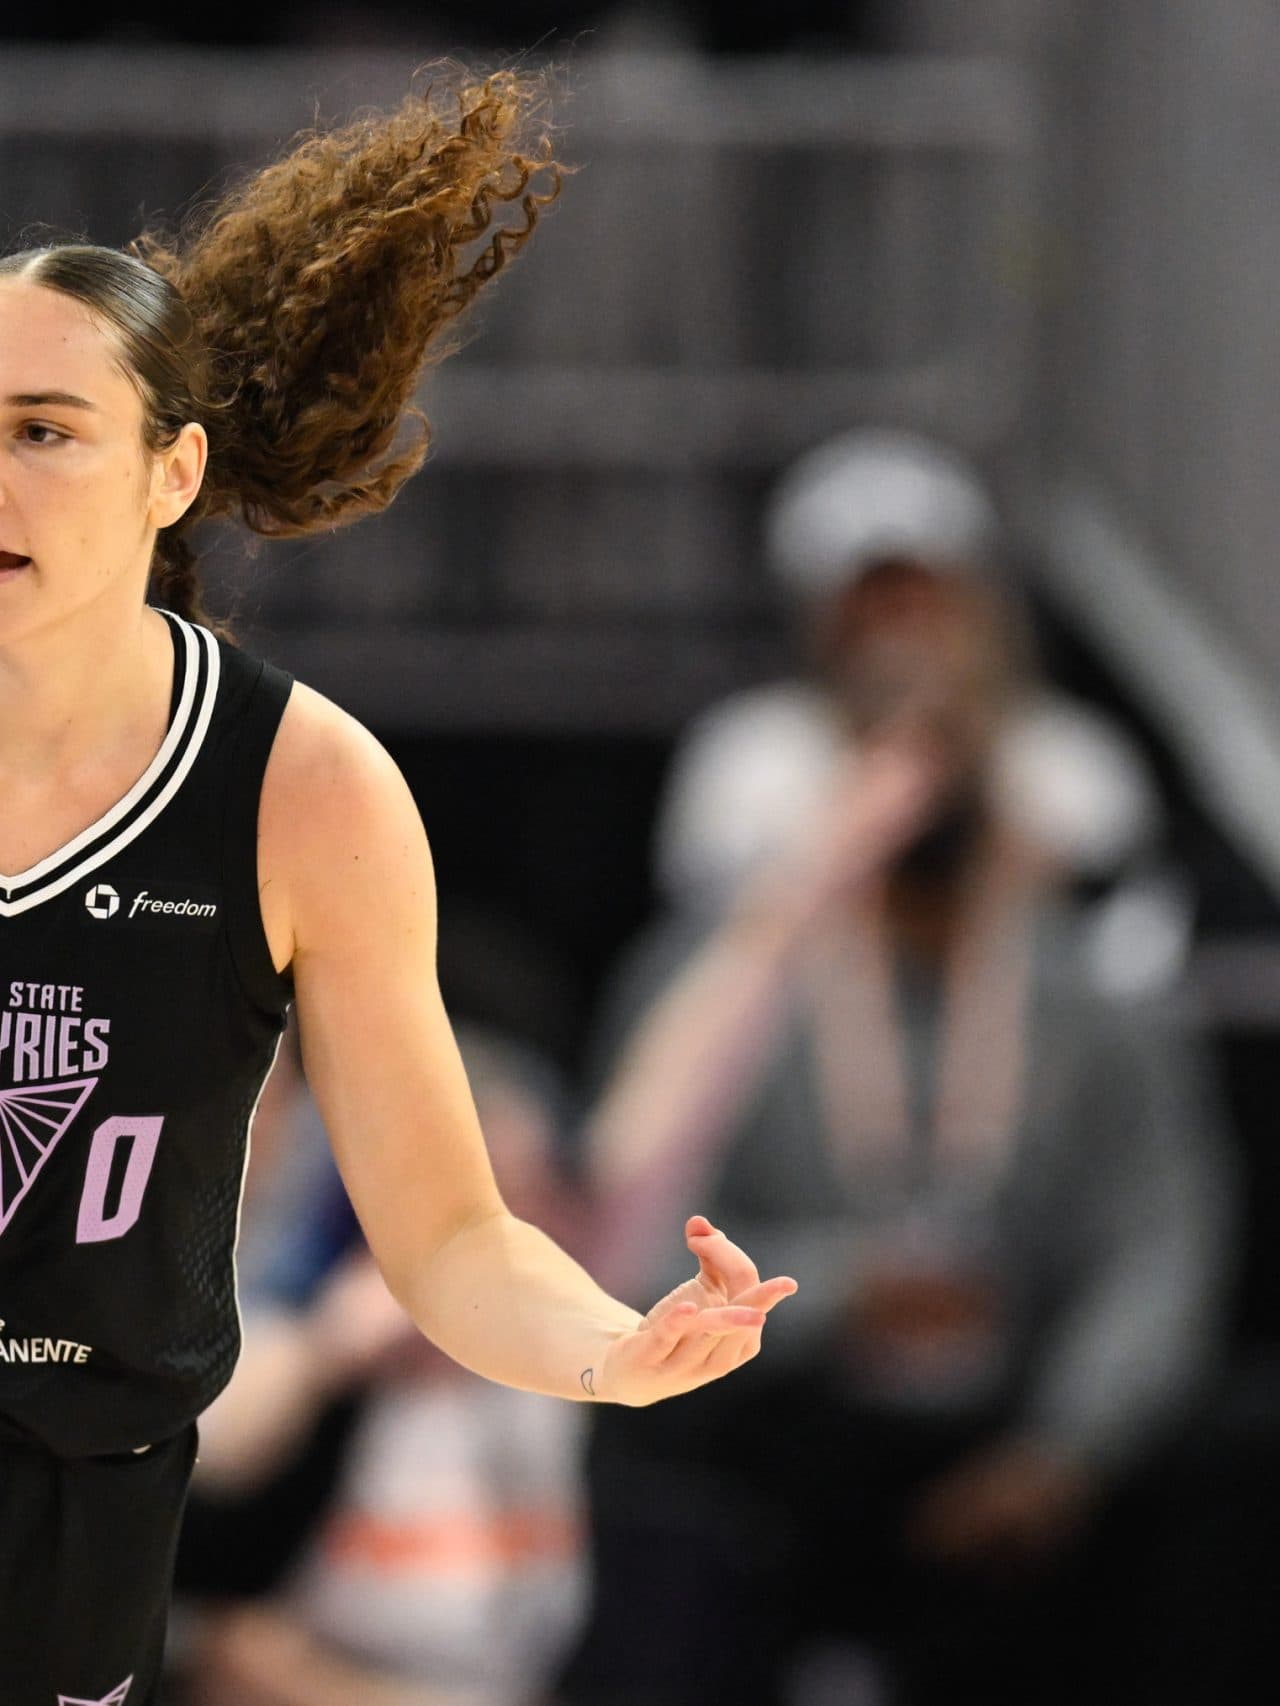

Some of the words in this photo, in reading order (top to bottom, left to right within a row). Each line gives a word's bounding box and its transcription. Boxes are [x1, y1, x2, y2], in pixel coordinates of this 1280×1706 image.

[128, 891, 217, 919] freedom
[9, 981, 84, 1012] STATE
[76, 1116, 164, 1243] 0
